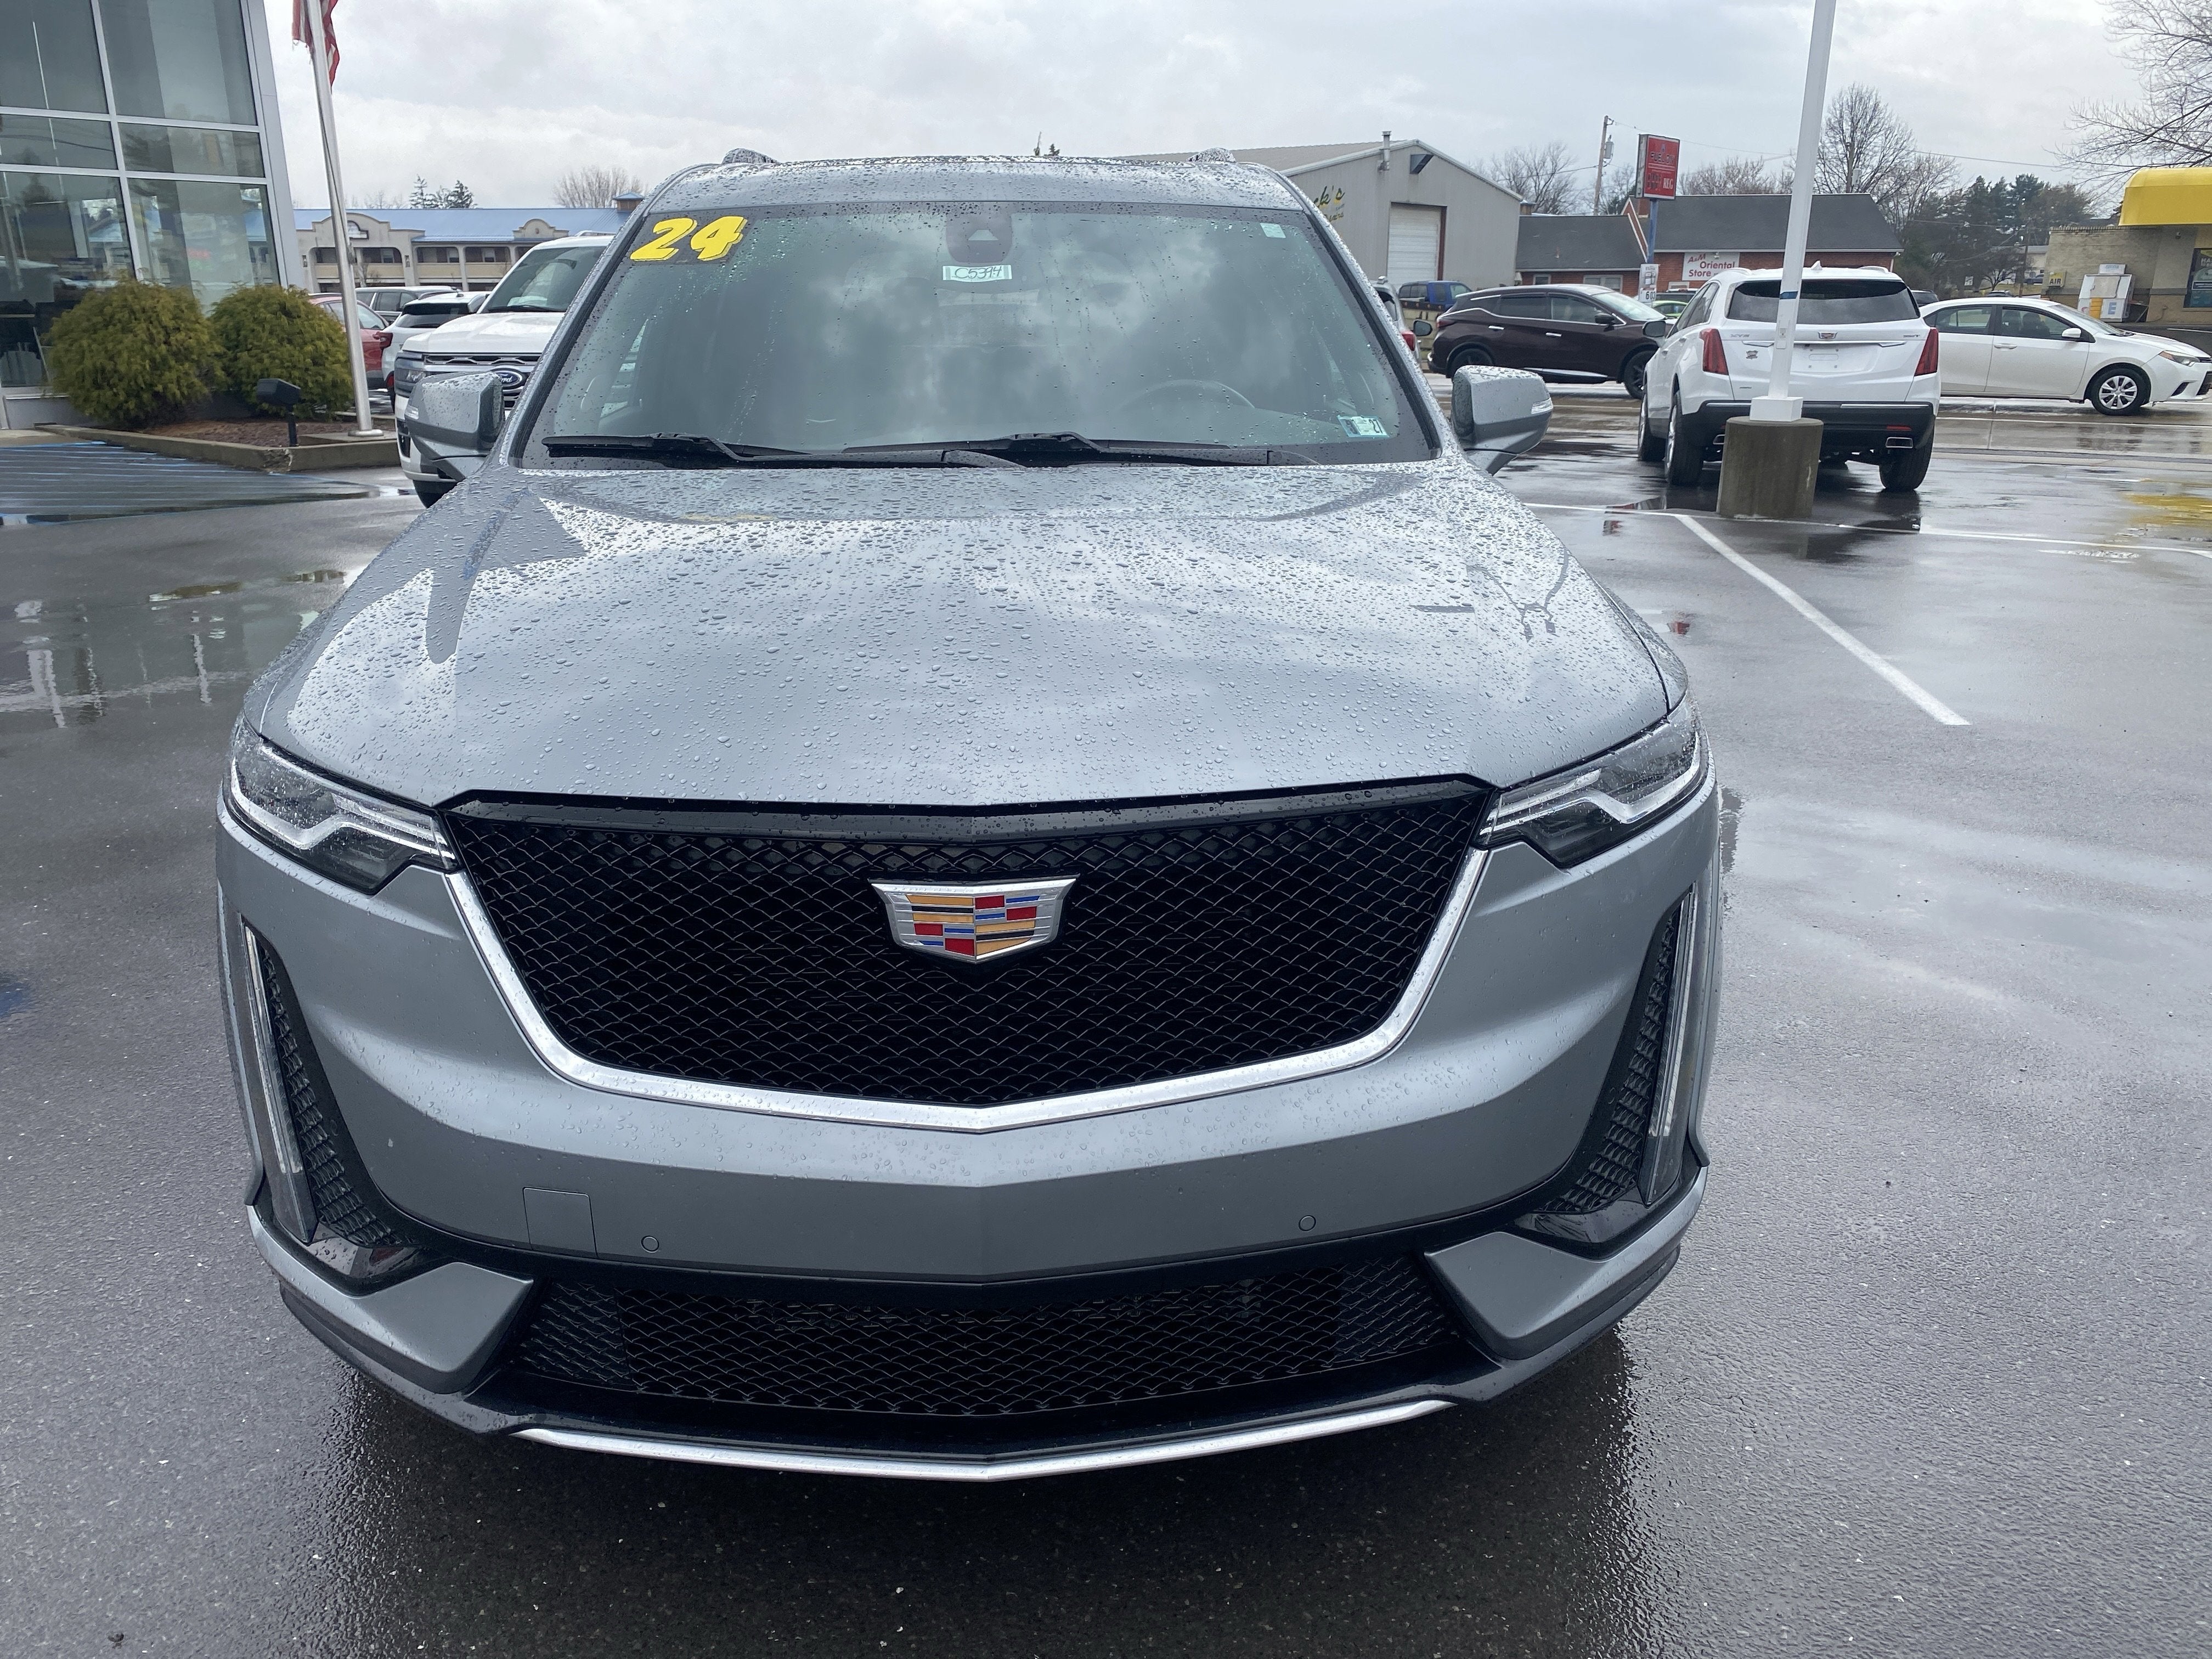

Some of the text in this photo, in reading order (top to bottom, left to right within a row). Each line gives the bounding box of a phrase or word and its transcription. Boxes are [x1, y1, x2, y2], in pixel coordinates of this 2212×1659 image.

[1663, 178, 1674, 189] REG
[630, 216, 748, 262] 24
[1688, 253, 1706, 264] A&M
